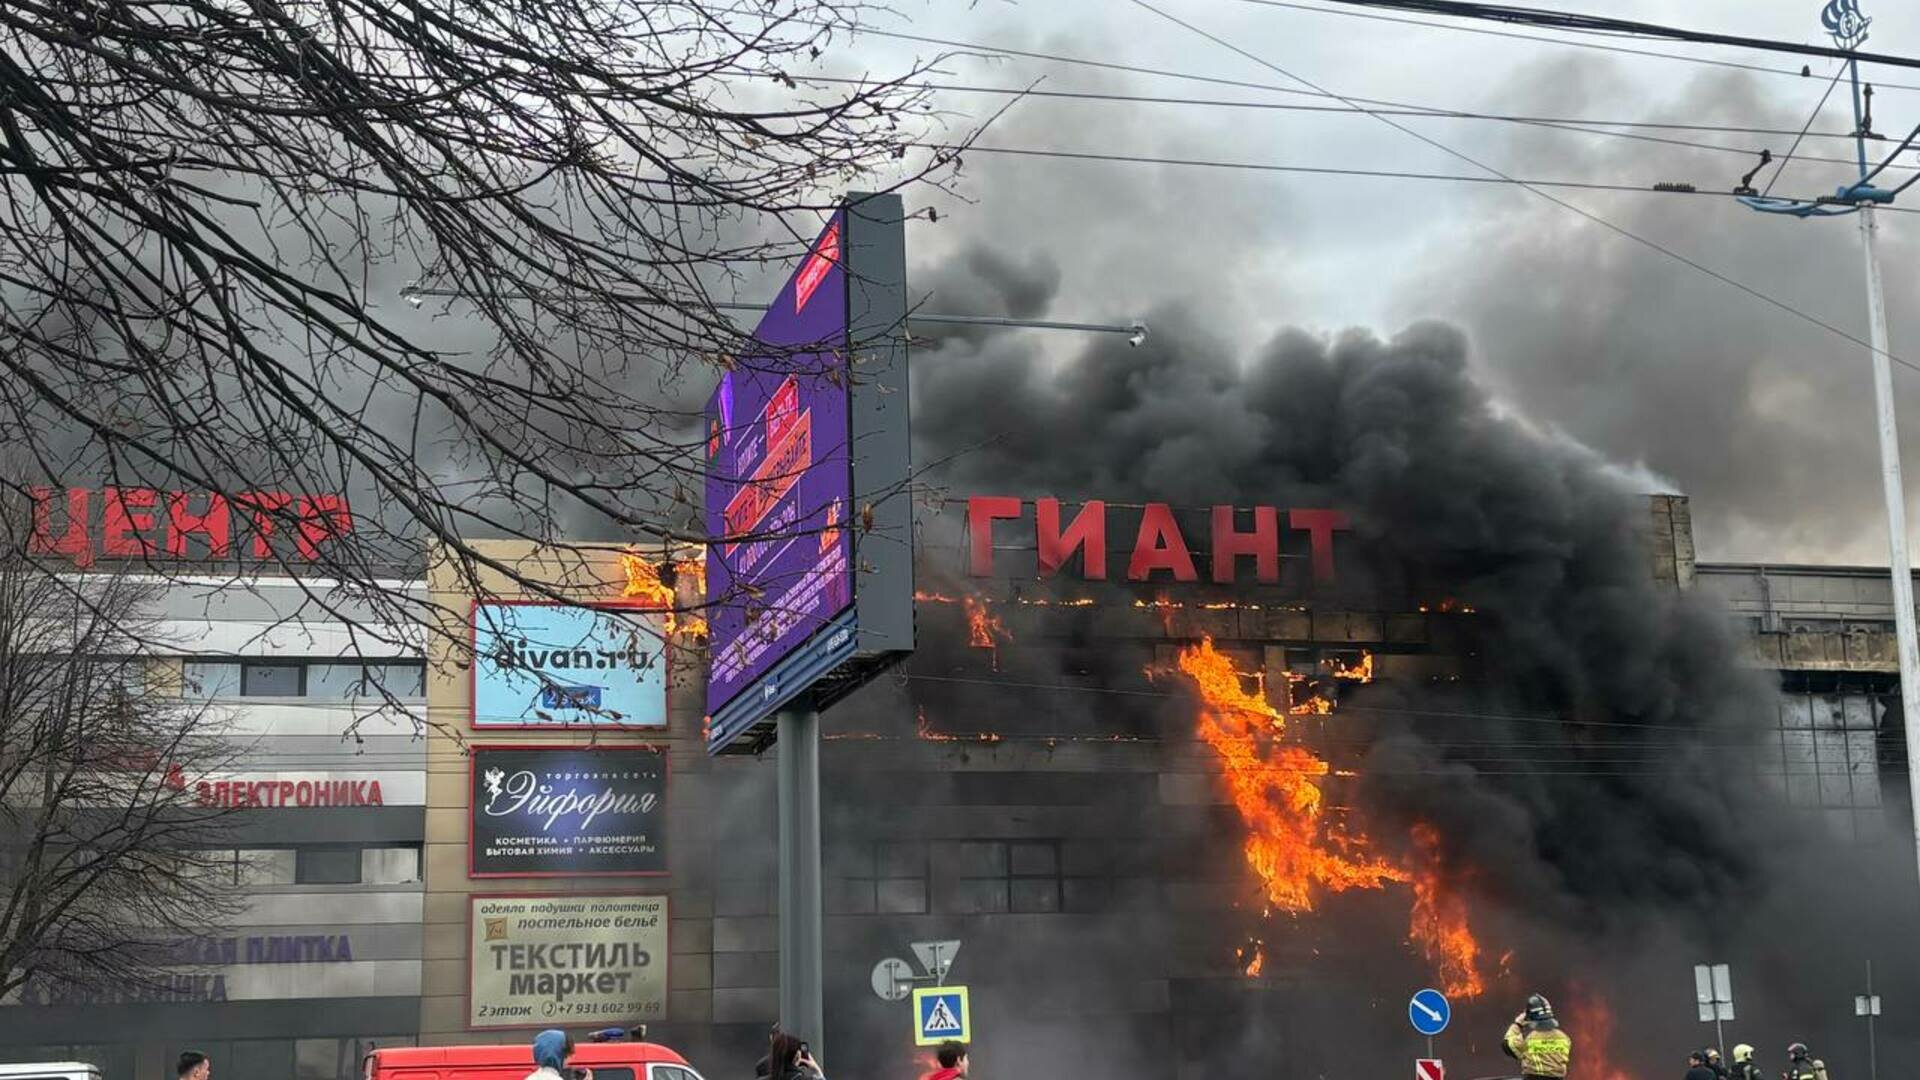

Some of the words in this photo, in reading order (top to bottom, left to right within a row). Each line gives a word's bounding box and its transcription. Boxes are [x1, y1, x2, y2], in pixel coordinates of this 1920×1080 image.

[28, 485, 353, 570] ЦЕНТР
[967, 496, 1352, 584] ГИАНТ
[494, 640, 650, 670] divan.ru
[195, 779, 384, 808] ЭЛЕКТРОНИКА
[484, 770, 658, 831] Эйфория
[486, 847, 535, 856] БЫТОВАЯ
[536, 846, 573, 855] ХИМИЯ
[589, 846, 655, 855] АКСЕССУАРЫ
[495, 837, 558, 846] КОСМЕТИКА
[573, 835, 646, 845] ПАРФЮМЕРИЯ
[517, 916, 611, 929] постельное
[614, 914, 659, 928] бельё
[530, 902, 585, 916] подушки
[247, 934, 353, 962] ПЛИТКА
[490, 942, 651, 971] ТЕКСТИЛЬ
[508, 971, 633, 1002] маркет
[478, 1005, 488, 1017] 2
[488, 1005, 533, 1017] этаж
[558, 1003, 574, 1014] +7
[576, 1002, 599, 1014] 931
[601, 1002, 625, 1014] 602
